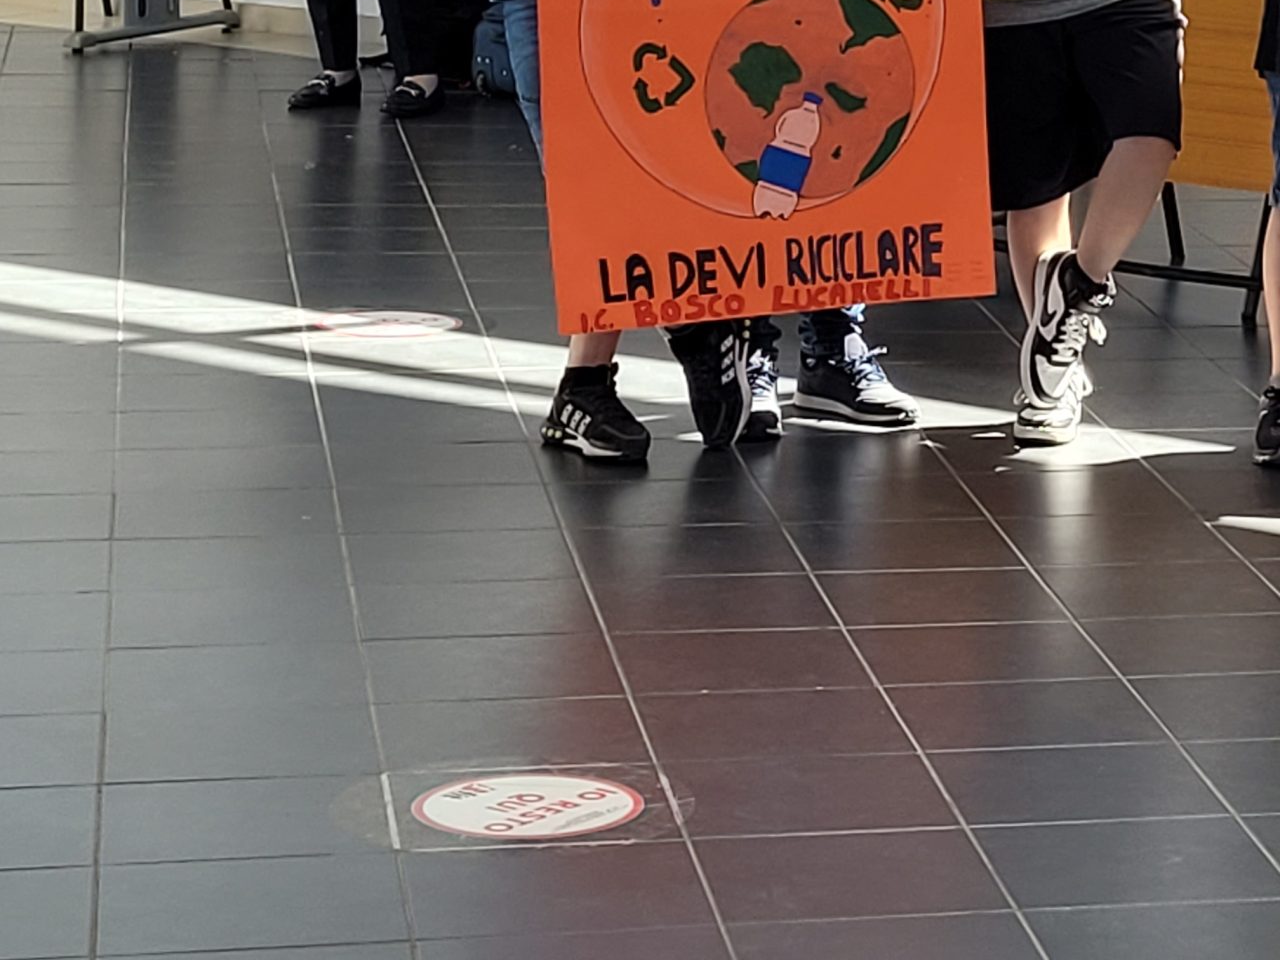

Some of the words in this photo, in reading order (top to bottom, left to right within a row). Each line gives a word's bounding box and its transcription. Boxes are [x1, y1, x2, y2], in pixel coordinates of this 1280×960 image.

[598, 253, 655, 304] LA
[668, 242, 766, 299] DEVI
[786, 223, 943, 286] RICICLARE
[633, 294, 746, 328] BOSCO
[772, 279, 931, 312] LUCARELLI
[484, 799, 581, 833] RESTO
[485, 793, 545, 813] QUI
